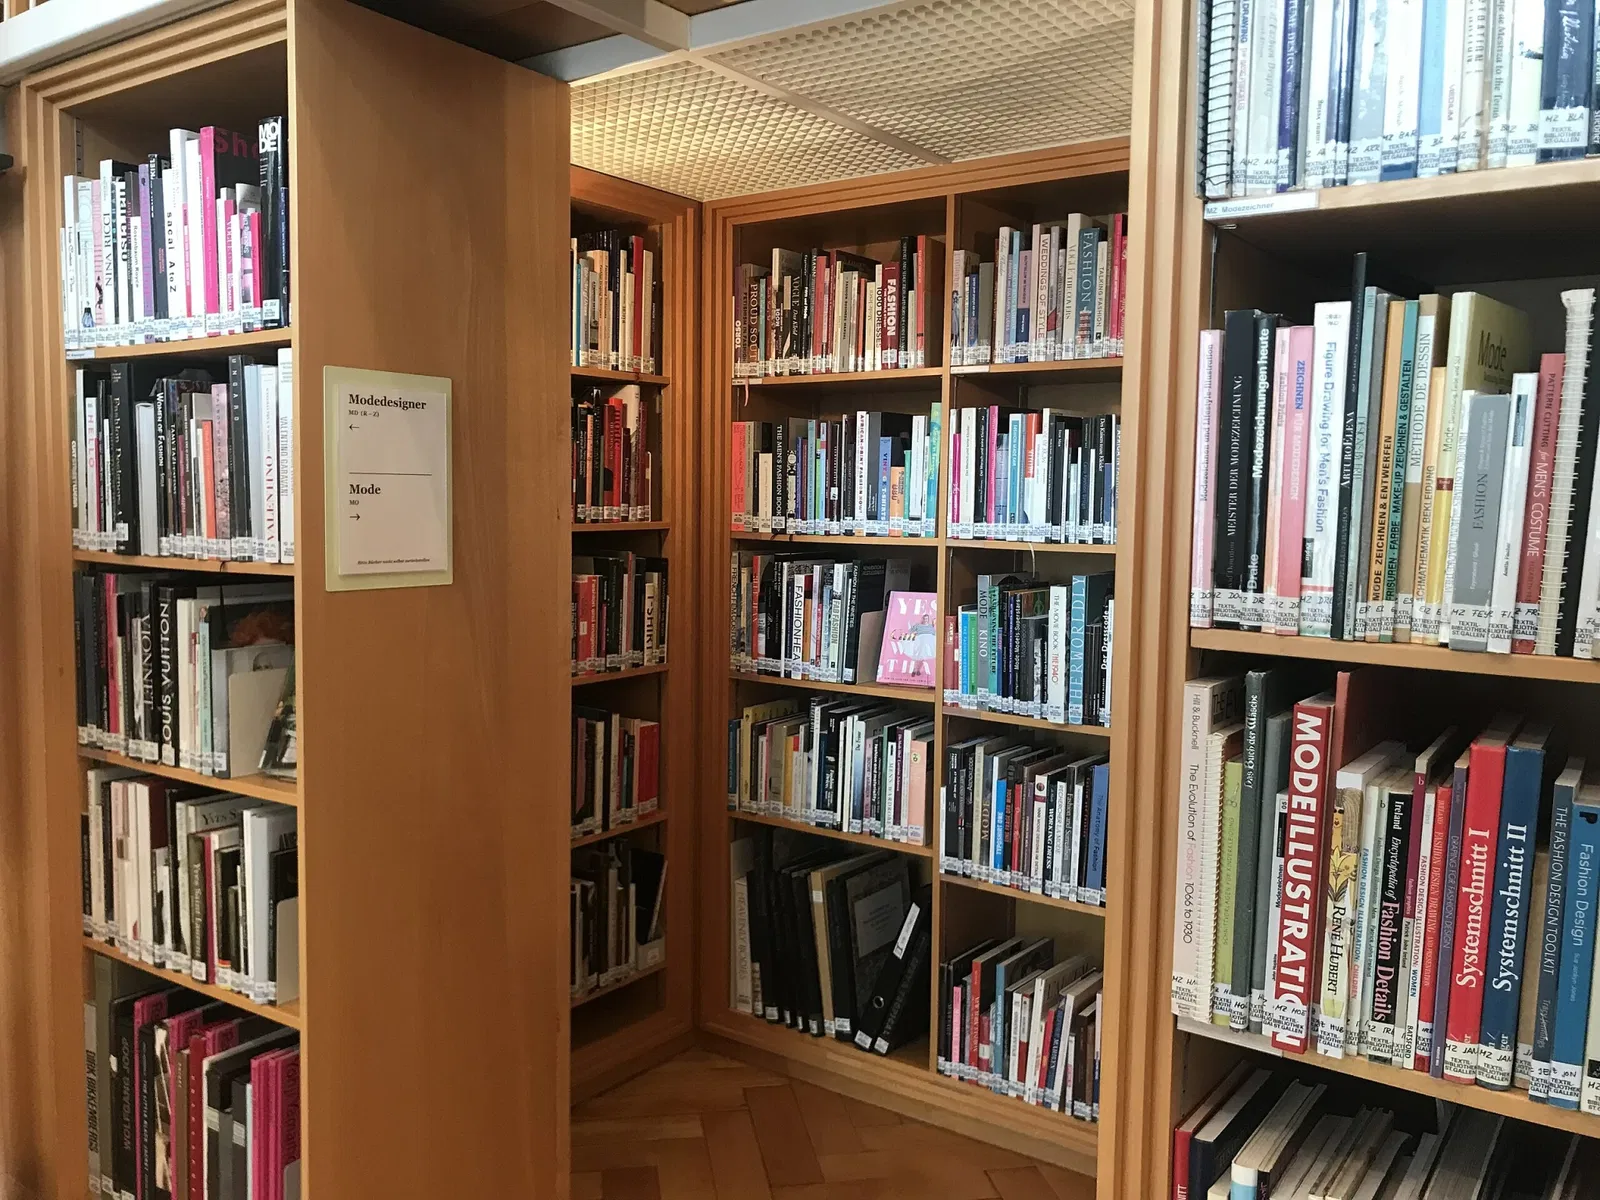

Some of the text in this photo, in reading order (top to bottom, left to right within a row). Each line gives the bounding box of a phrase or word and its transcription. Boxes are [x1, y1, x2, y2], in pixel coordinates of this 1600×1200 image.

[1240, 3, 1249, 43] DRAWING
[1496, 23, 1506, 62] Mestiza
[1286, 33, 1295, 72] DESIGN
[1496, 64, 1503, 75] to
[1495, 77, 1503, 92] the
[167, 212, 175, 250] sacai
[1206, 206, 1218, 215] MZ
[103, 213, 113, 286] NINA RICCI
[168, 261, 176, 269] A
[1081, 232, 1093, 303] FASHION
[749, 284, 758, 324] PROUD
[887, 279, 896, 336] FASHION
[1038, 238, 1048, 338] WEDDINGS OF STYLE
[1477, 330, 1507, 372] Mode
[231, 357, 239, 422] UNGARO
[348, 394, 427, 410] Modedesigner
[1252, 328, 1270, 478] Modezeichnungen heute
[1295, 360, 1305, 410] ZEICHNEN
[1400, 360, 1411, 411] GESTALTEN
[1410, 333, 1431, 468] MÉTHODE DE DESSIN
[1545, 373, 1556, 409] PATTERN
[156, 392, 164, 422] WOMEN
[87, 414, 95, 468] HELLO
[1316, 341, 1337, 533] Figure Drawing for Men's Fashion
[1395, 422, 1407, 468] ZEICHNEN
[1443, 427, 1453, 452] Mode
[1540, 411, 1551, 448] CUTTING
[280, 415, 289, 498] VALENTINO GARAVANI
[1227, 375, 1243, 536] MEISTER DER MODEZEICHNUNG
[1290, 431, 1303, 500] MODEDESIGN
[1379, 435, 1392, 500] ENTWERFEN
[1541, 450, 1550, 461] for
[265, 454, 275, 542] VALENTINO
[349, 484, 381, 495] Mode
[1392, 471, 1403, 514] MAKE-UP
[1533, 462, 1548, 497] MEN'S
[1473, 473, 1488, 530] FASHION
[1374, 521, 1386, 565] ZEICHNEN
[1390, 521, 1400, 551] FARBE
[1415, 465, 1435, 601] ACHMATHEMATIK BEKLEIDUNG
[1526, 503, 1544, 557] COSTUME
[1247, 554, 1259, 589] Drake
[1372, 571, 1382, 601] MODE
[1385, 556, 1398, 600] FRISUREN
[646, 594, 654, 651] T-SHIRT
[793, 585, 803, 661] FASHIONHEA
[831, 614, 839, 644] FASHION
[979, 590, 988, 657] MODE KINO
[1101, 610, 1109, 652] Dresscode
[141, 613, 154, 711] VIONNET
[160, 602, 172, 687] VUITTON
[1071, 576, 1085, 724] OHERWORLDLY
[1193, 693, 1201, 706] Hill
[1191, 716, 1199, 750] Bucknell
[1189, 763, 1199, 781] The
[1093, 807, 1102, 836] Anatomy
[1187, 784, 1198, 829] Evolution
[1393, 801, 1404, 830] Ireland
[1186, 831, 1196, 840] of
[1092, 846, 1100, 872] Fashion
[1185, 842, 1196, 880] Fashion
[1361, 848, 1369, 879] FASHION
[1387, 836, 1402, 888] Encyclopedia
[1419, 855, 1428, 887] FASHION
[1184, 882, 1194, 908] 1066
[1275, 864, 1283, 908] Modezeichnen
[1358, 881, 1367, 909] DESIGN
[1385, 889, 1396, 901] of
[1417, 888, 1426, 916] DESIGN
[1543, 807, 1568, 976] THE FASHION DESIGN TOOLKIT
[1571, 843, 1593, 947] Fashion Design
[1184, 909, 1193, 919] to
[1455, 827, 1490, 988] Systemschnitt I
[1492, 823, 1527, 992] Systemschnitt II
[1182, 920, 1193, 944] 1930
[1327, 905, 1346, 995] RENÉ HUBERT
[1378, 901, 1400, 960] Fashion
[1373, 965, 1395, 1022] Details
[1410, 969, 1419, 998] WOMEN
[86, 1050, 96, 1077] DIRK
